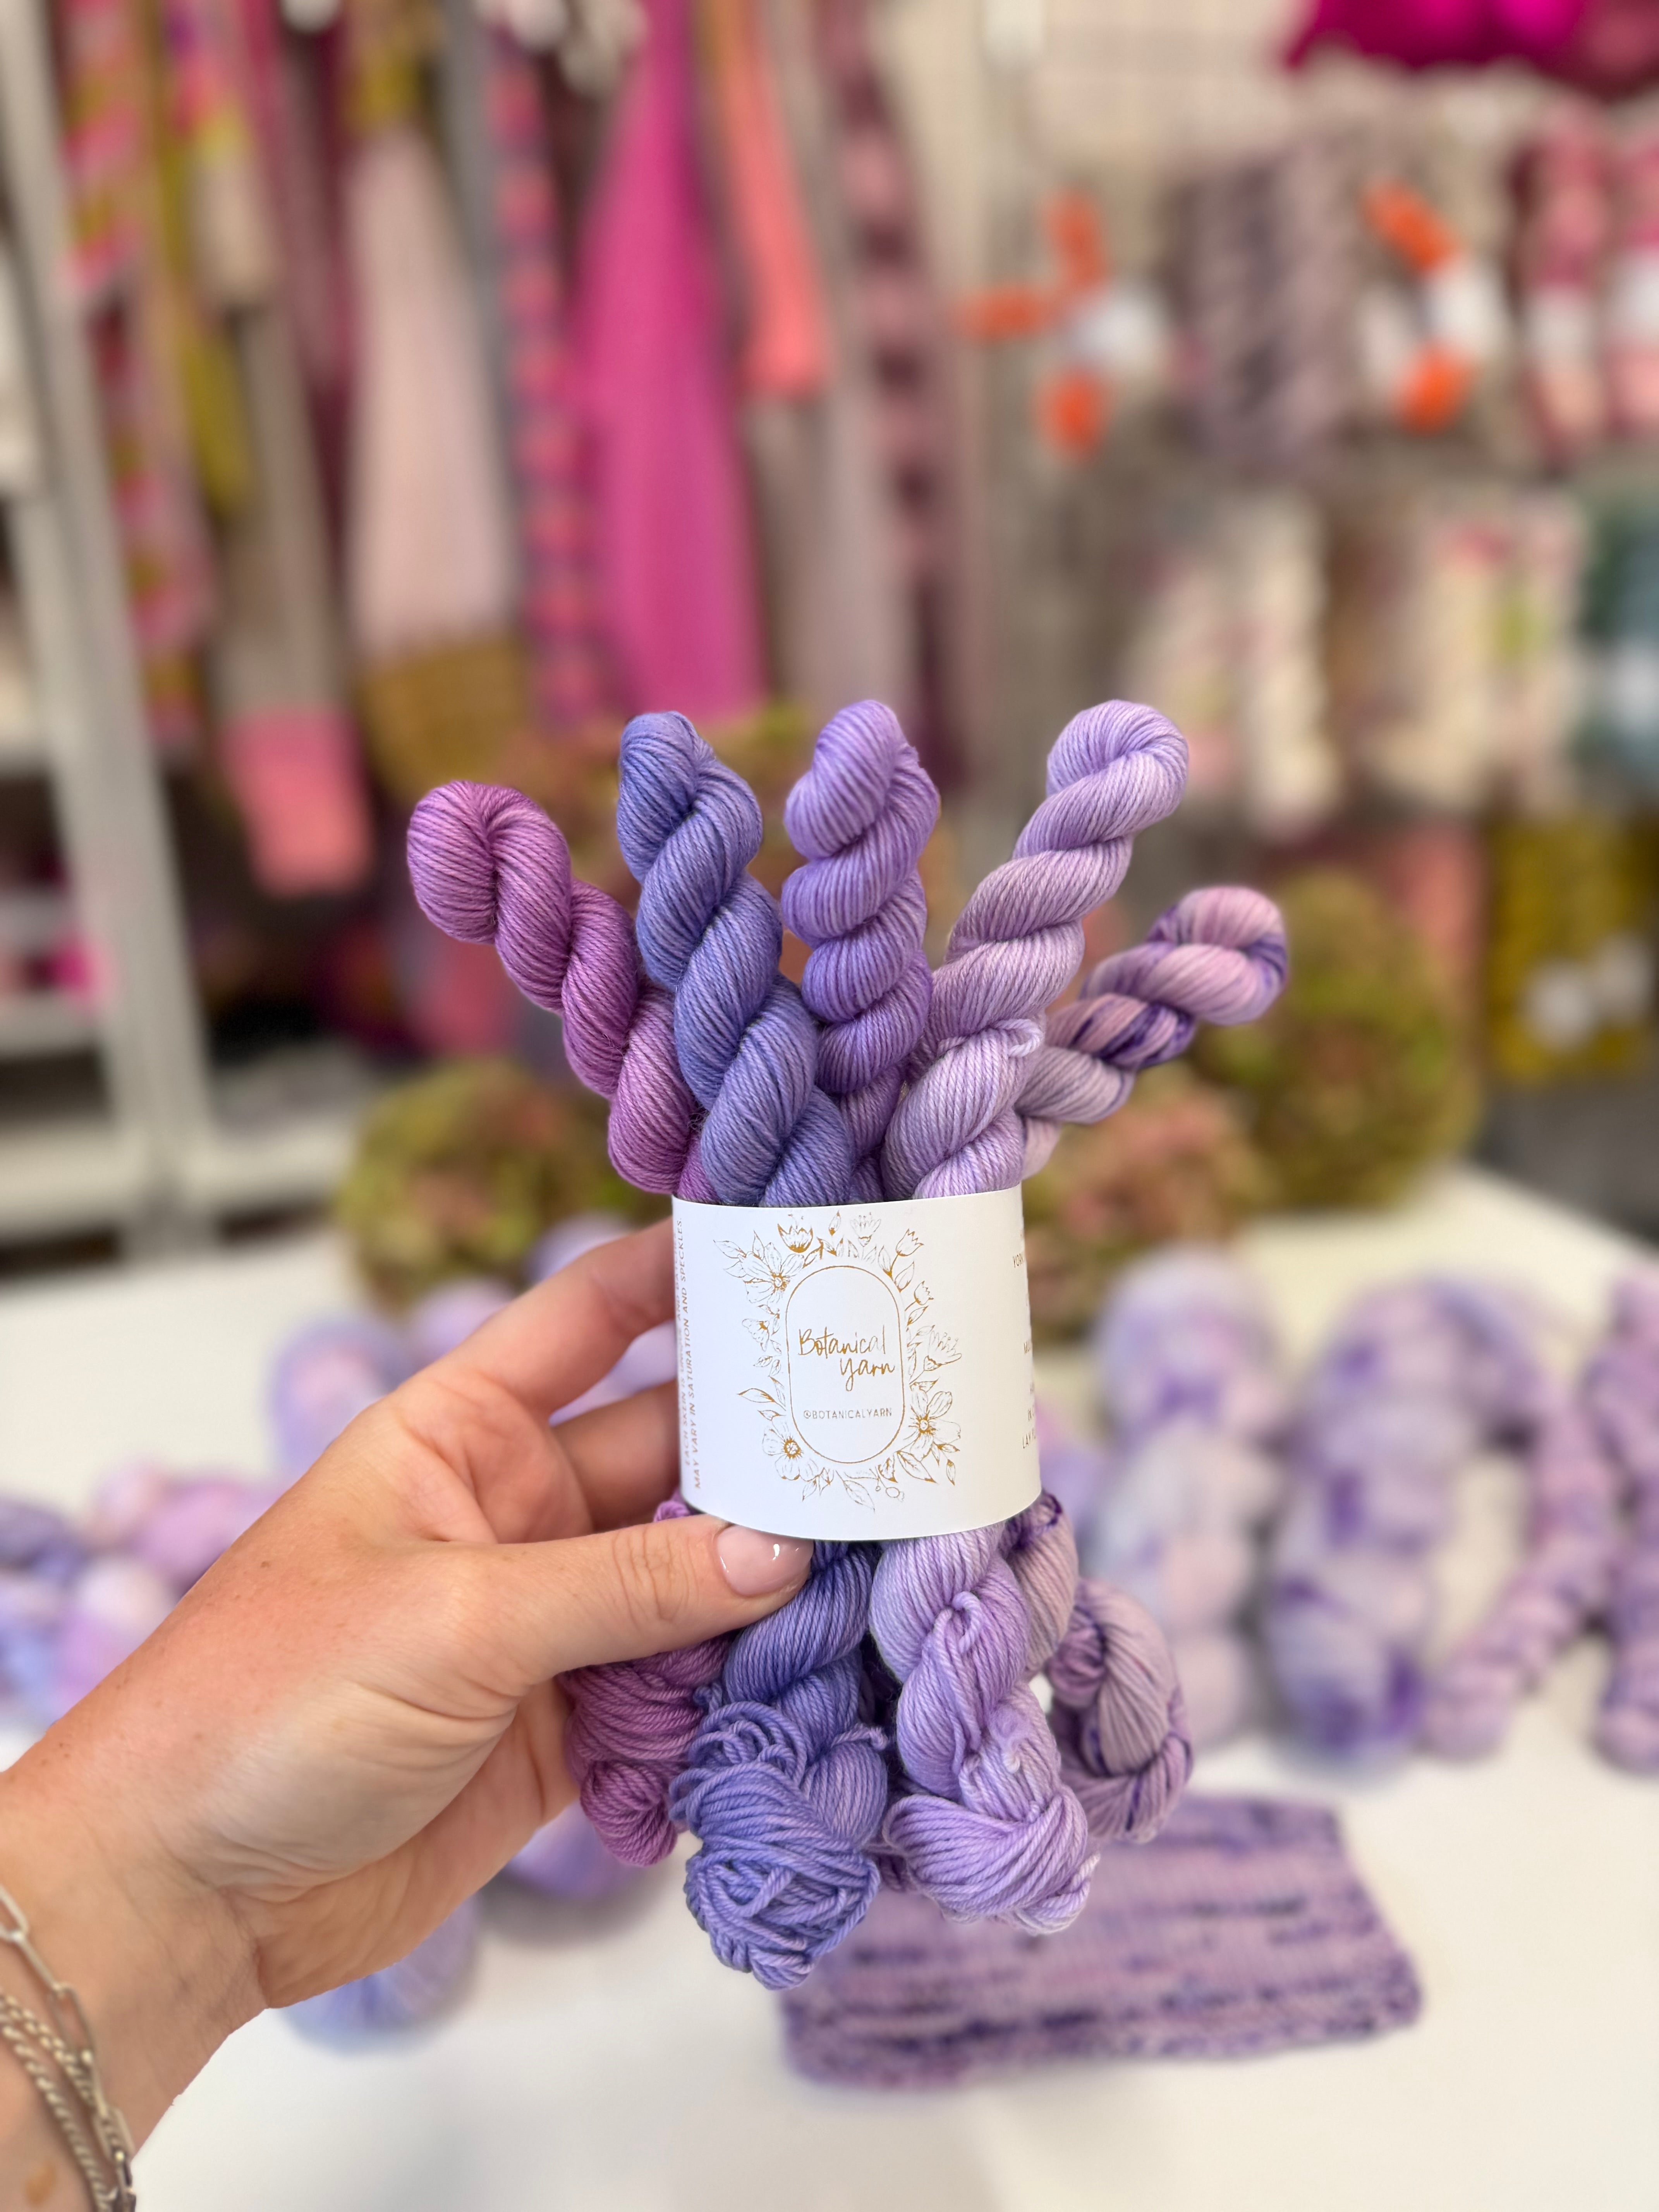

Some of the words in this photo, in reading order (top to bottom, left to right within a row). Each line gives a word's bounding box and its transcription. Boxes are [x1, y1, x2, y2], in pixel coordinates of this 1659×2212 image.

[677, 1218, 686, 1282] SPECKLES.
[798, 1324, 886, 1359] Botanical
[683, 1318, 694, 1399] SATURATION
[689, 1402, 696, 1416] IN
[803, 1407, 892, 1419] @BOTANICALYARN
[693, 1458, 701, 1489] MAY
